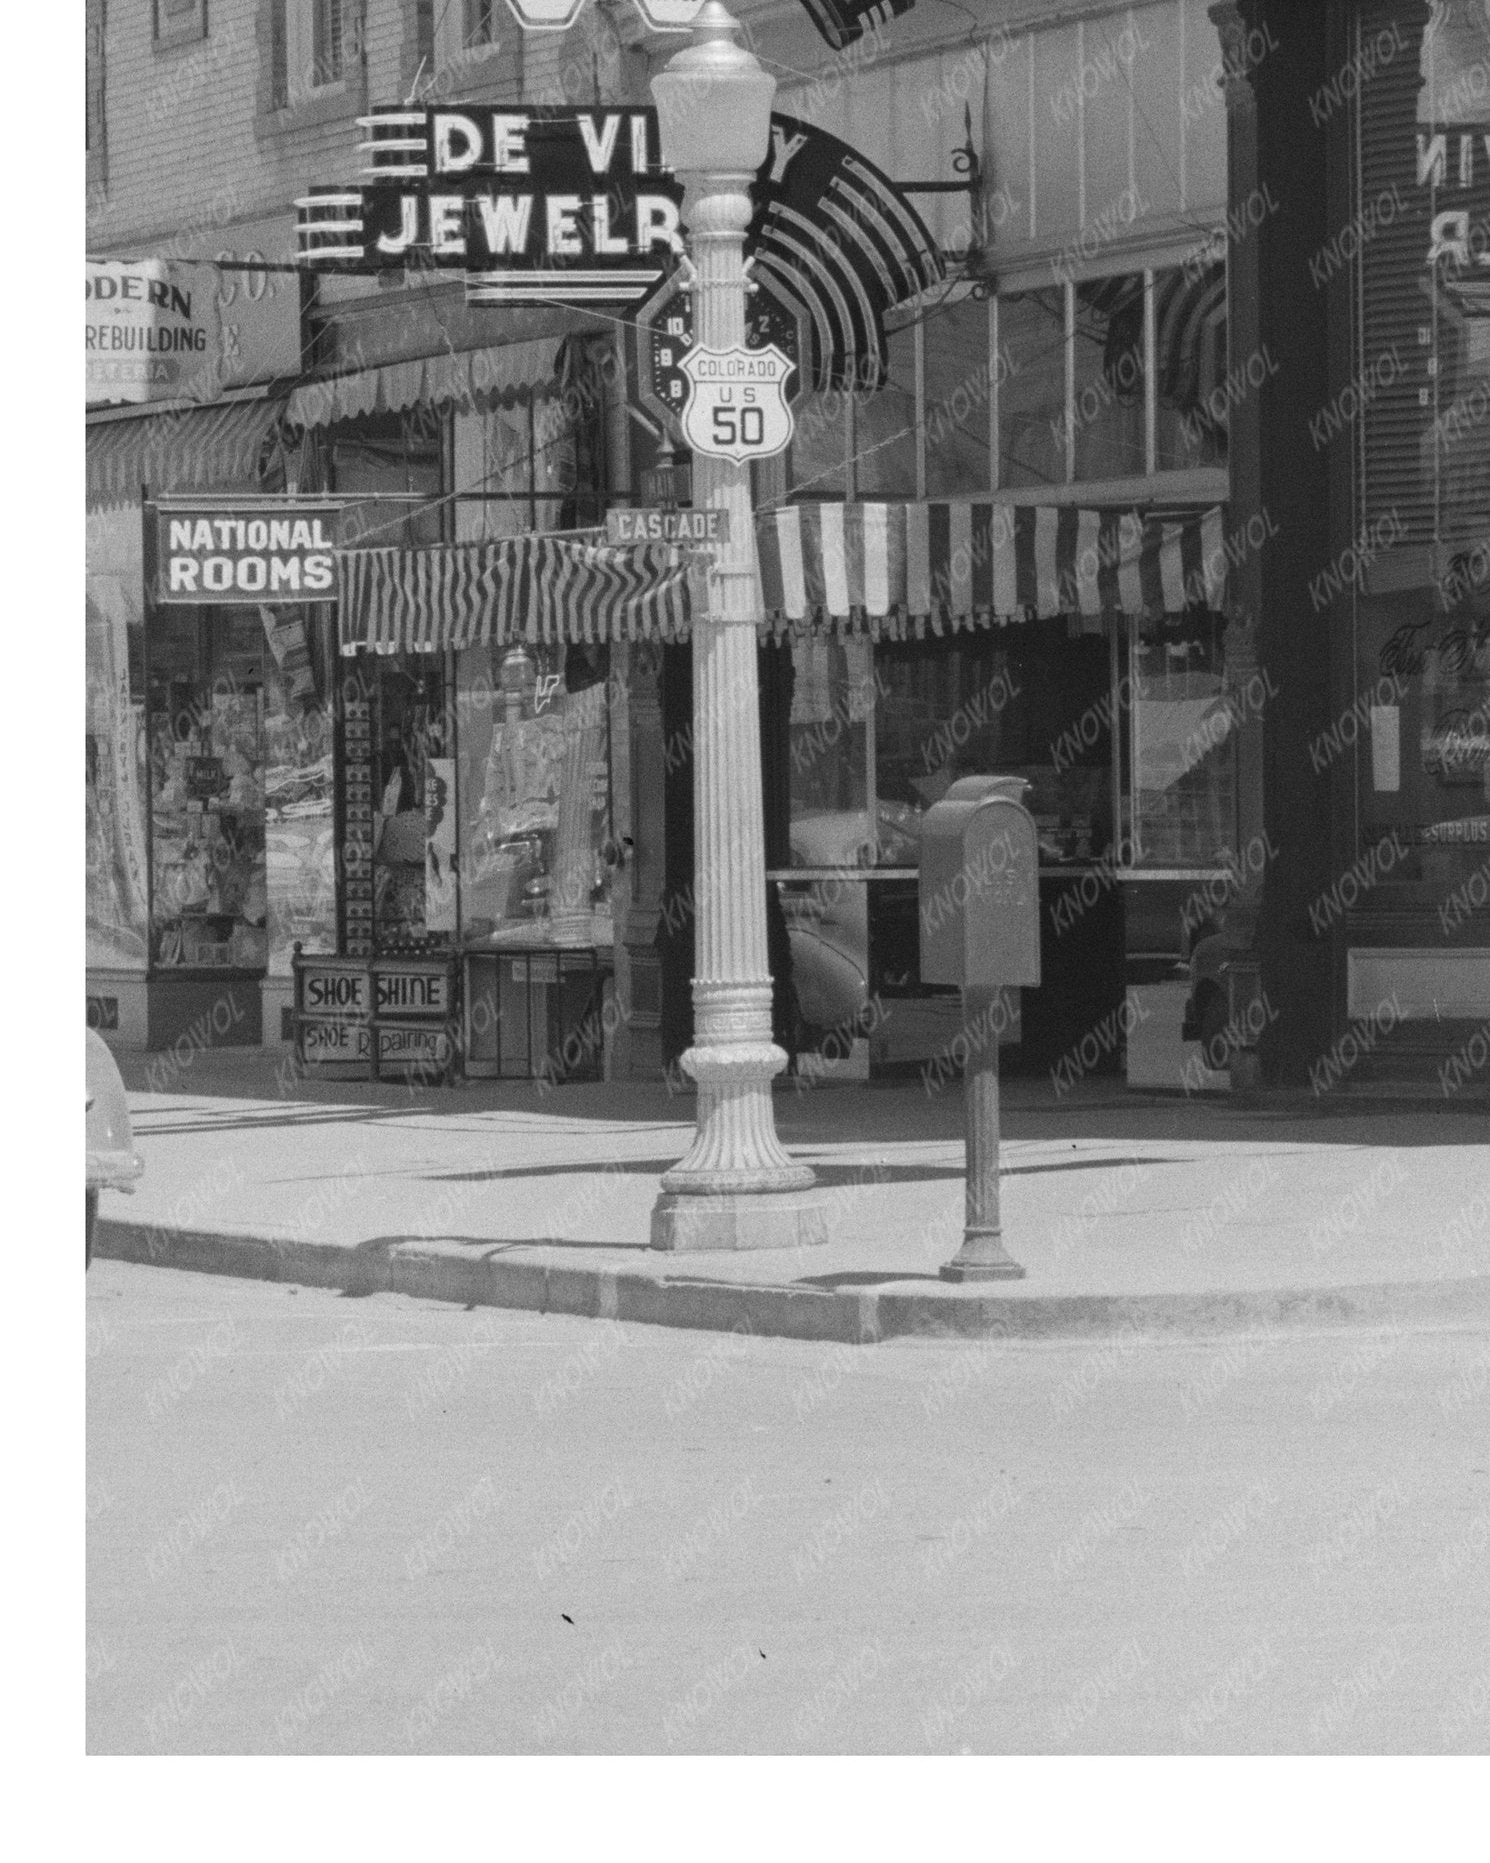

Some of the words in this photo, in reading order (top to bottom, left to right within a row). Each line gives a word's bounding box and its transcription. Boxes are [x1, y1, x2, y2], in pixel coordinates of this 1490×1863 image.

[433, 113, 530, 173] DE
[377, 192, 685, 254] JEWELR
[699, 360, 776, 377] COLORADO
[712, 406, 764, 445] 50
[170, 518, 333, 550] NATIONAL
[618, 513, 718, 539] CASCADE
[170, 555, 333, 591] ROOMS
[308, 977, 362, 1005] SHOE
[377, 977, 440, 1006] SHINE
[307, 1027, 349, 1047] SHOE
[358, 1032, 437, 1057] Rpairing
